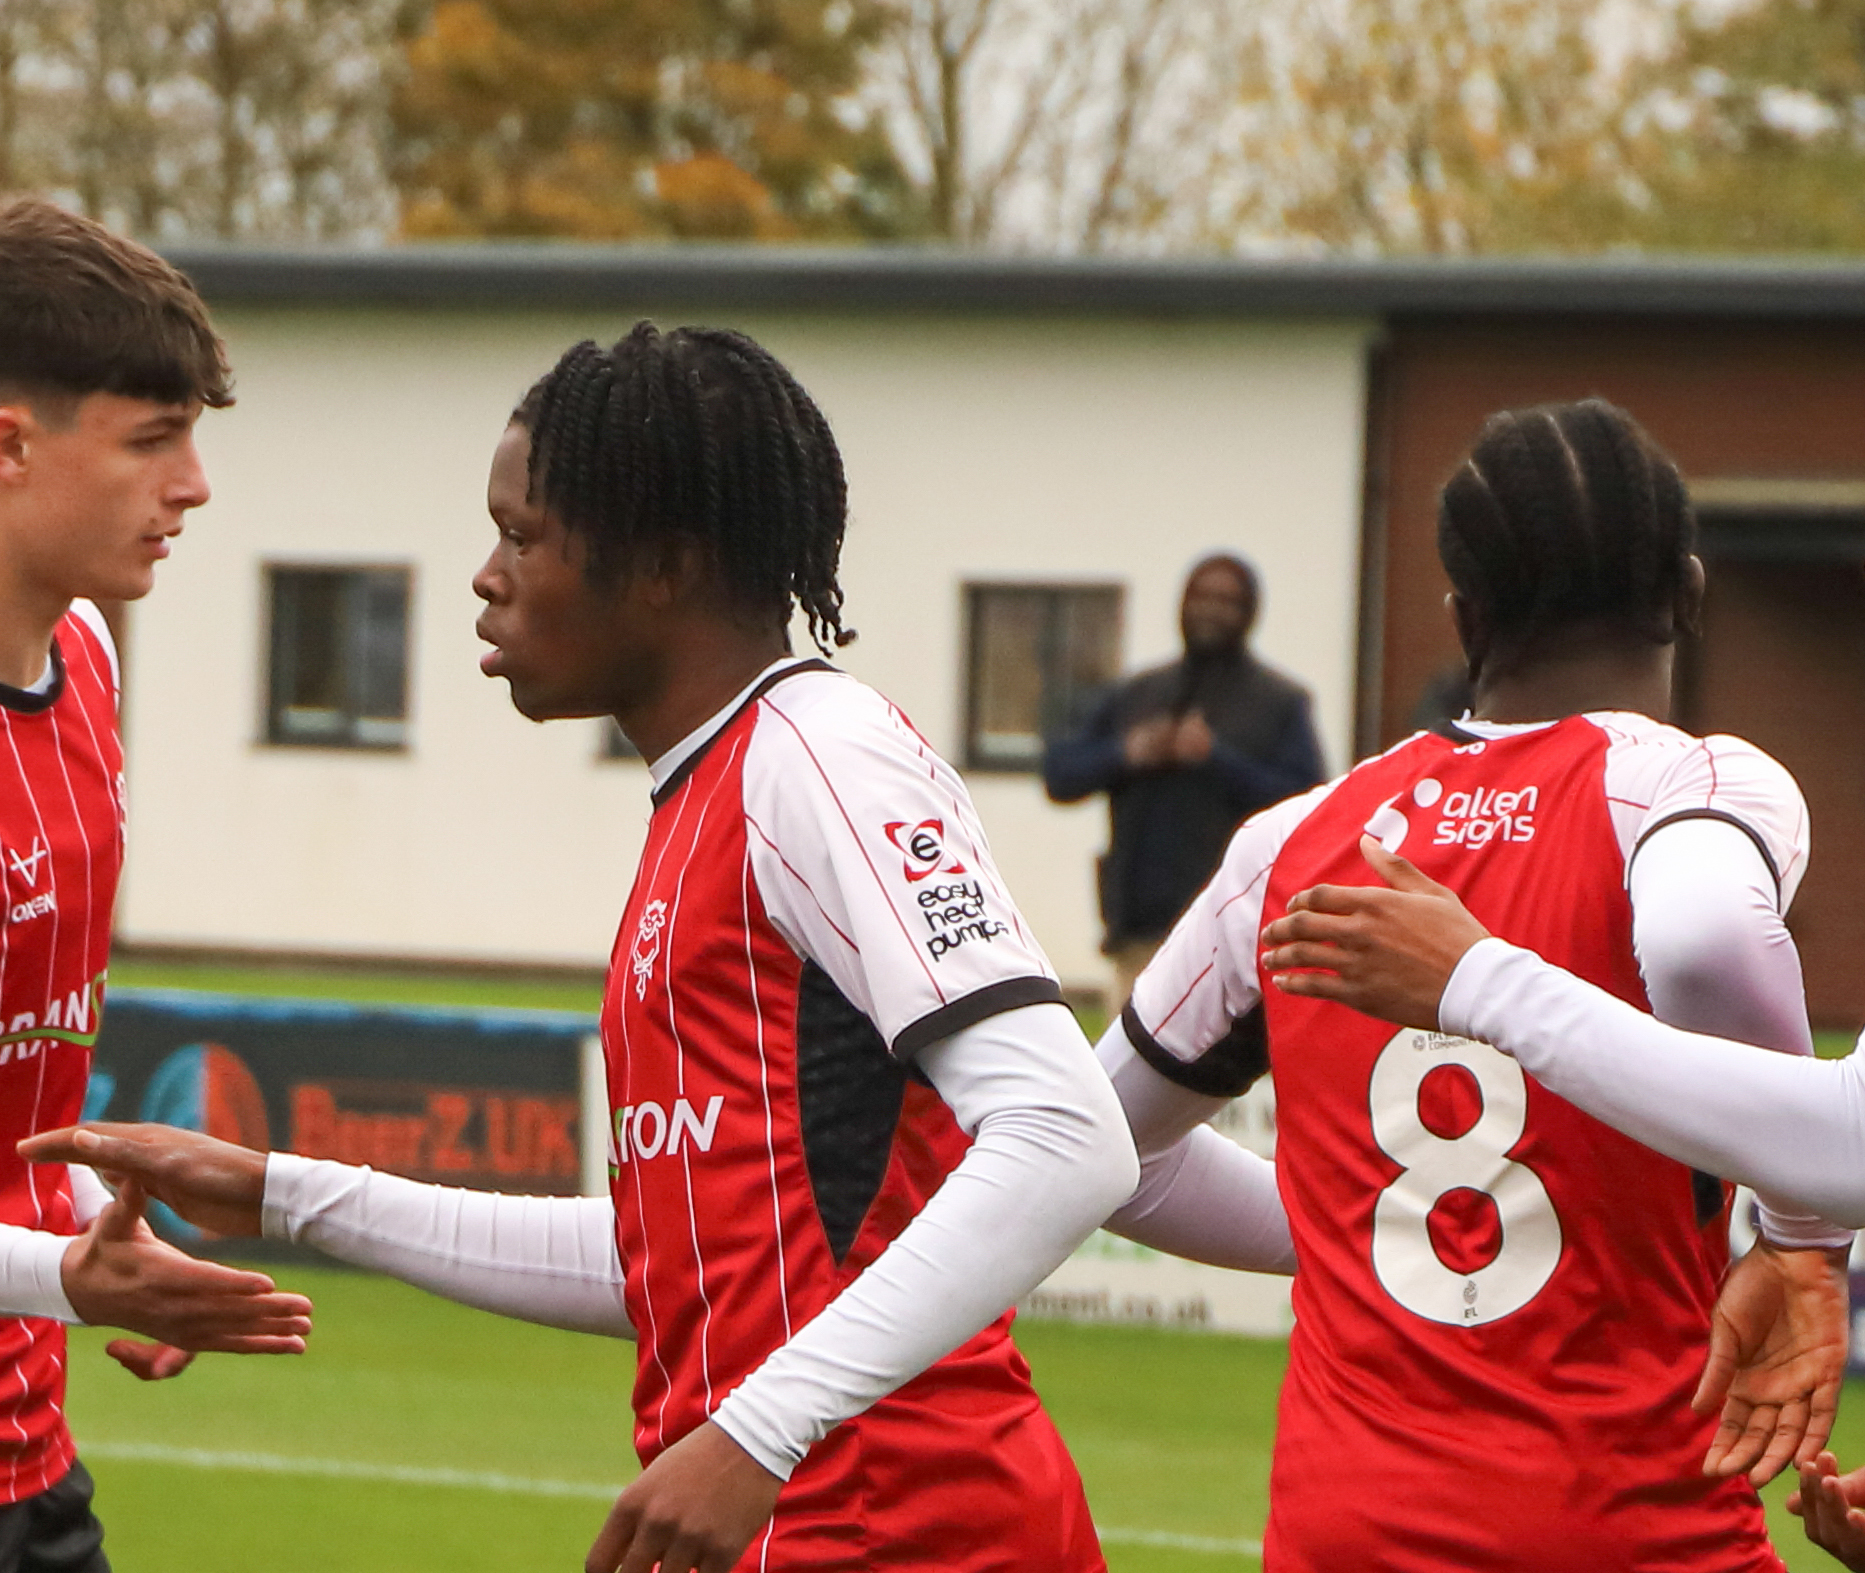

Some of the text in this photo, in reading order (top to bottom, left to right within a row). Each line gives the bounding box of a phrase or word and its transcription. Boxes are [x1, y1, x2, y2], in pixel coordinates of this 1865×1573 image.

[1452, 786, 1538, 819] allen
[1433, 815, 1535, 849] signs
[11, 890, 56, 923] OXEN
[917, 880, 984, 908] easy
[926, 920, 1009, 962] pumps
[1369, 1026, 1563, 1327] 8
